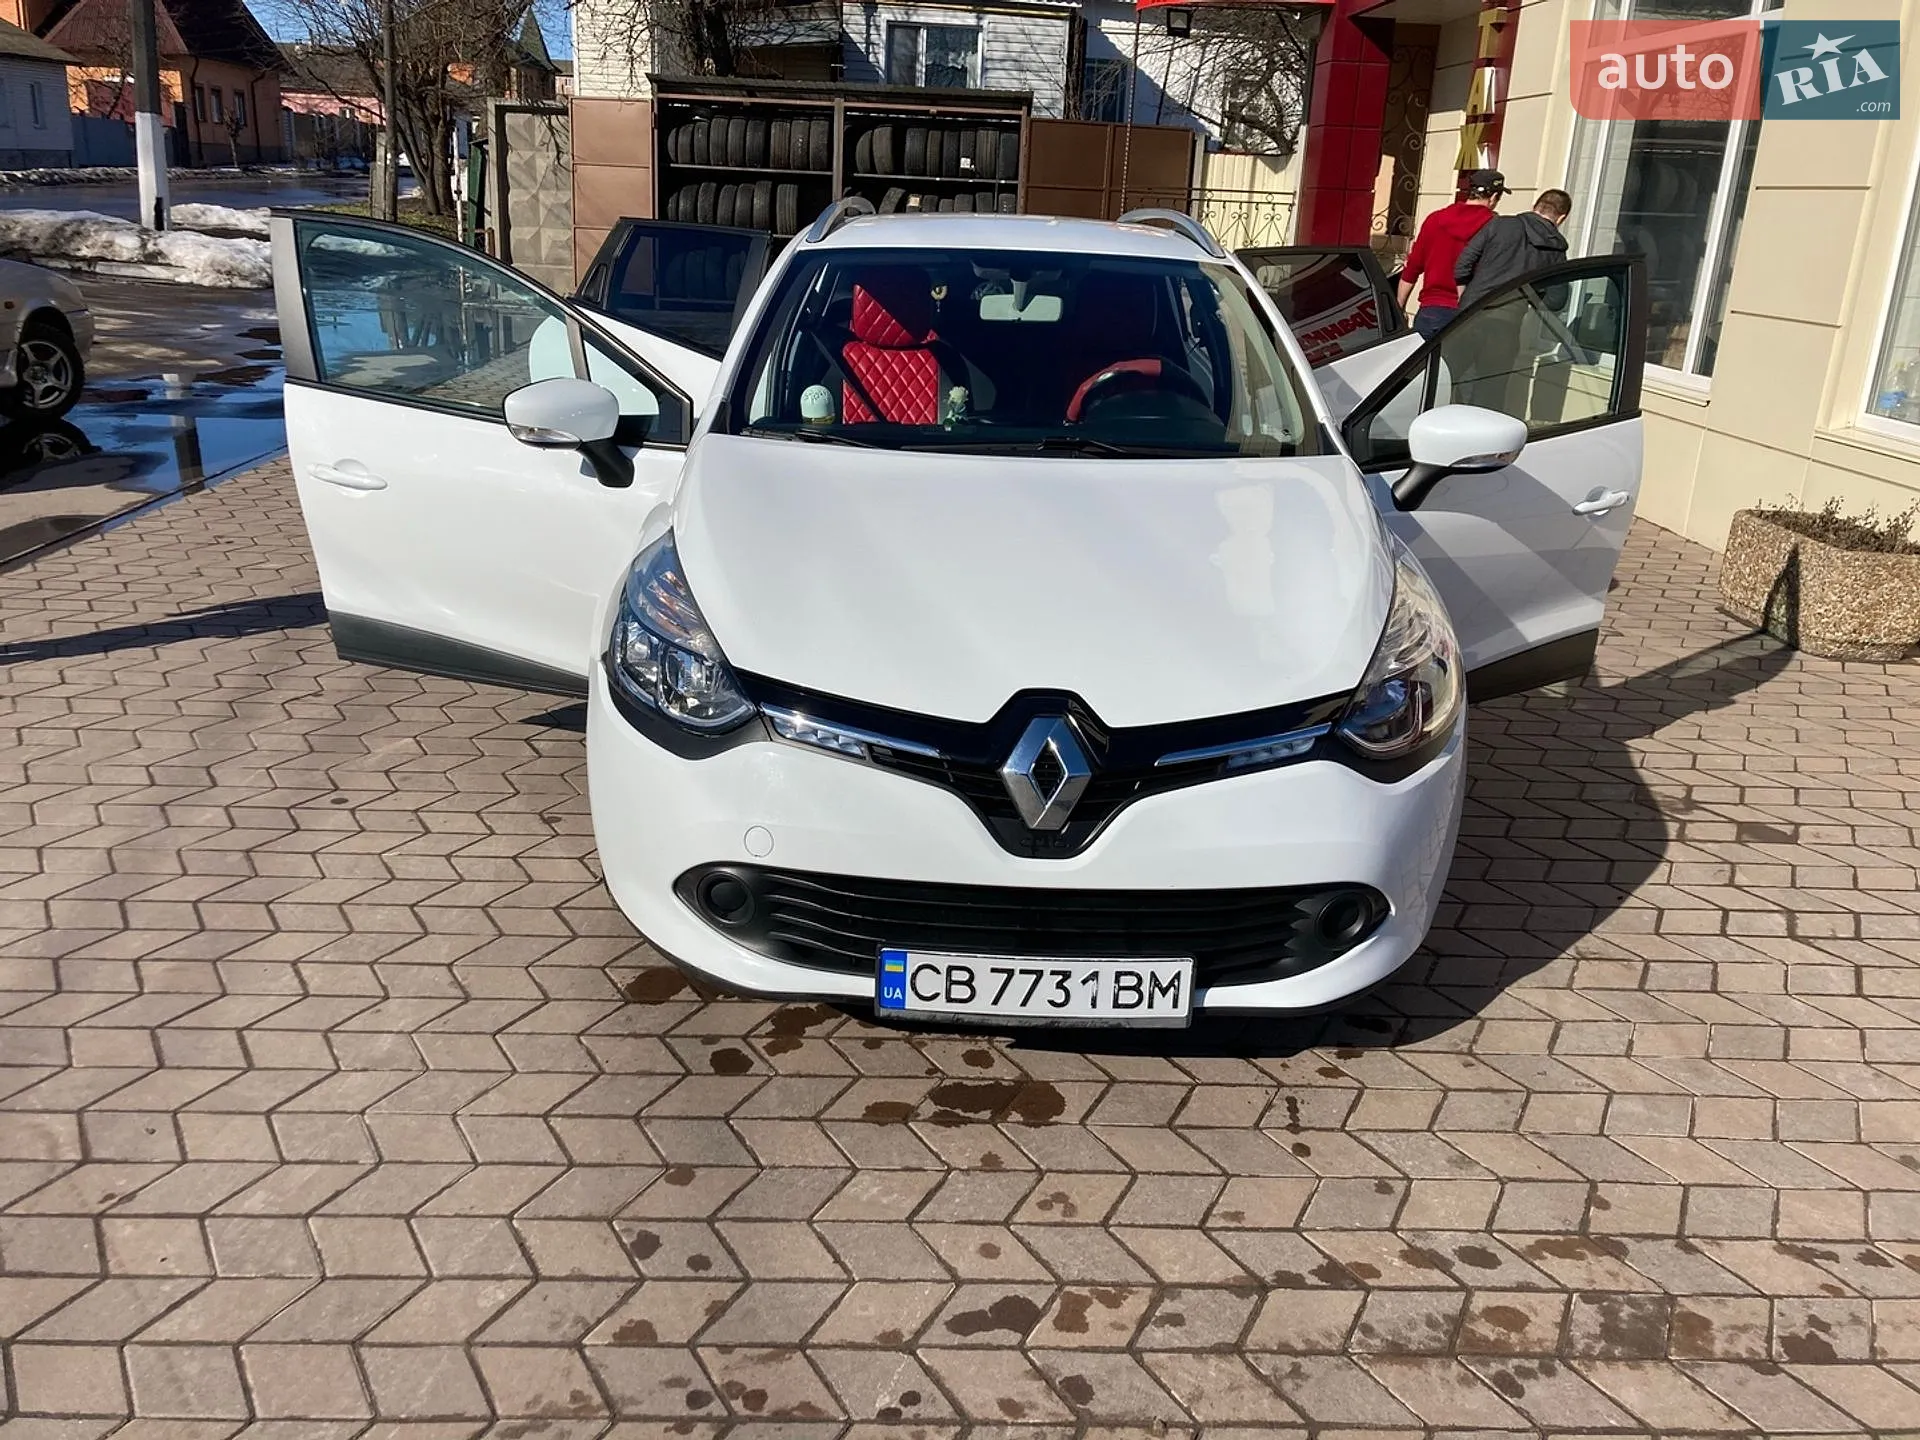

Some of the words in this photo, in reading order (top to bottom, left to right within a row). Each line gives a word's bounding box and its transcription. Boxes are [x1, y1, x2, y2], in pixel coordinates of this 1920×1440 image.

[884, 986, 903, 1000] UA
[910, 963, 976, 1003] CB
[990, 967, 1100, 1009] 7731
[1112, 970, 1181, 1010] BM
